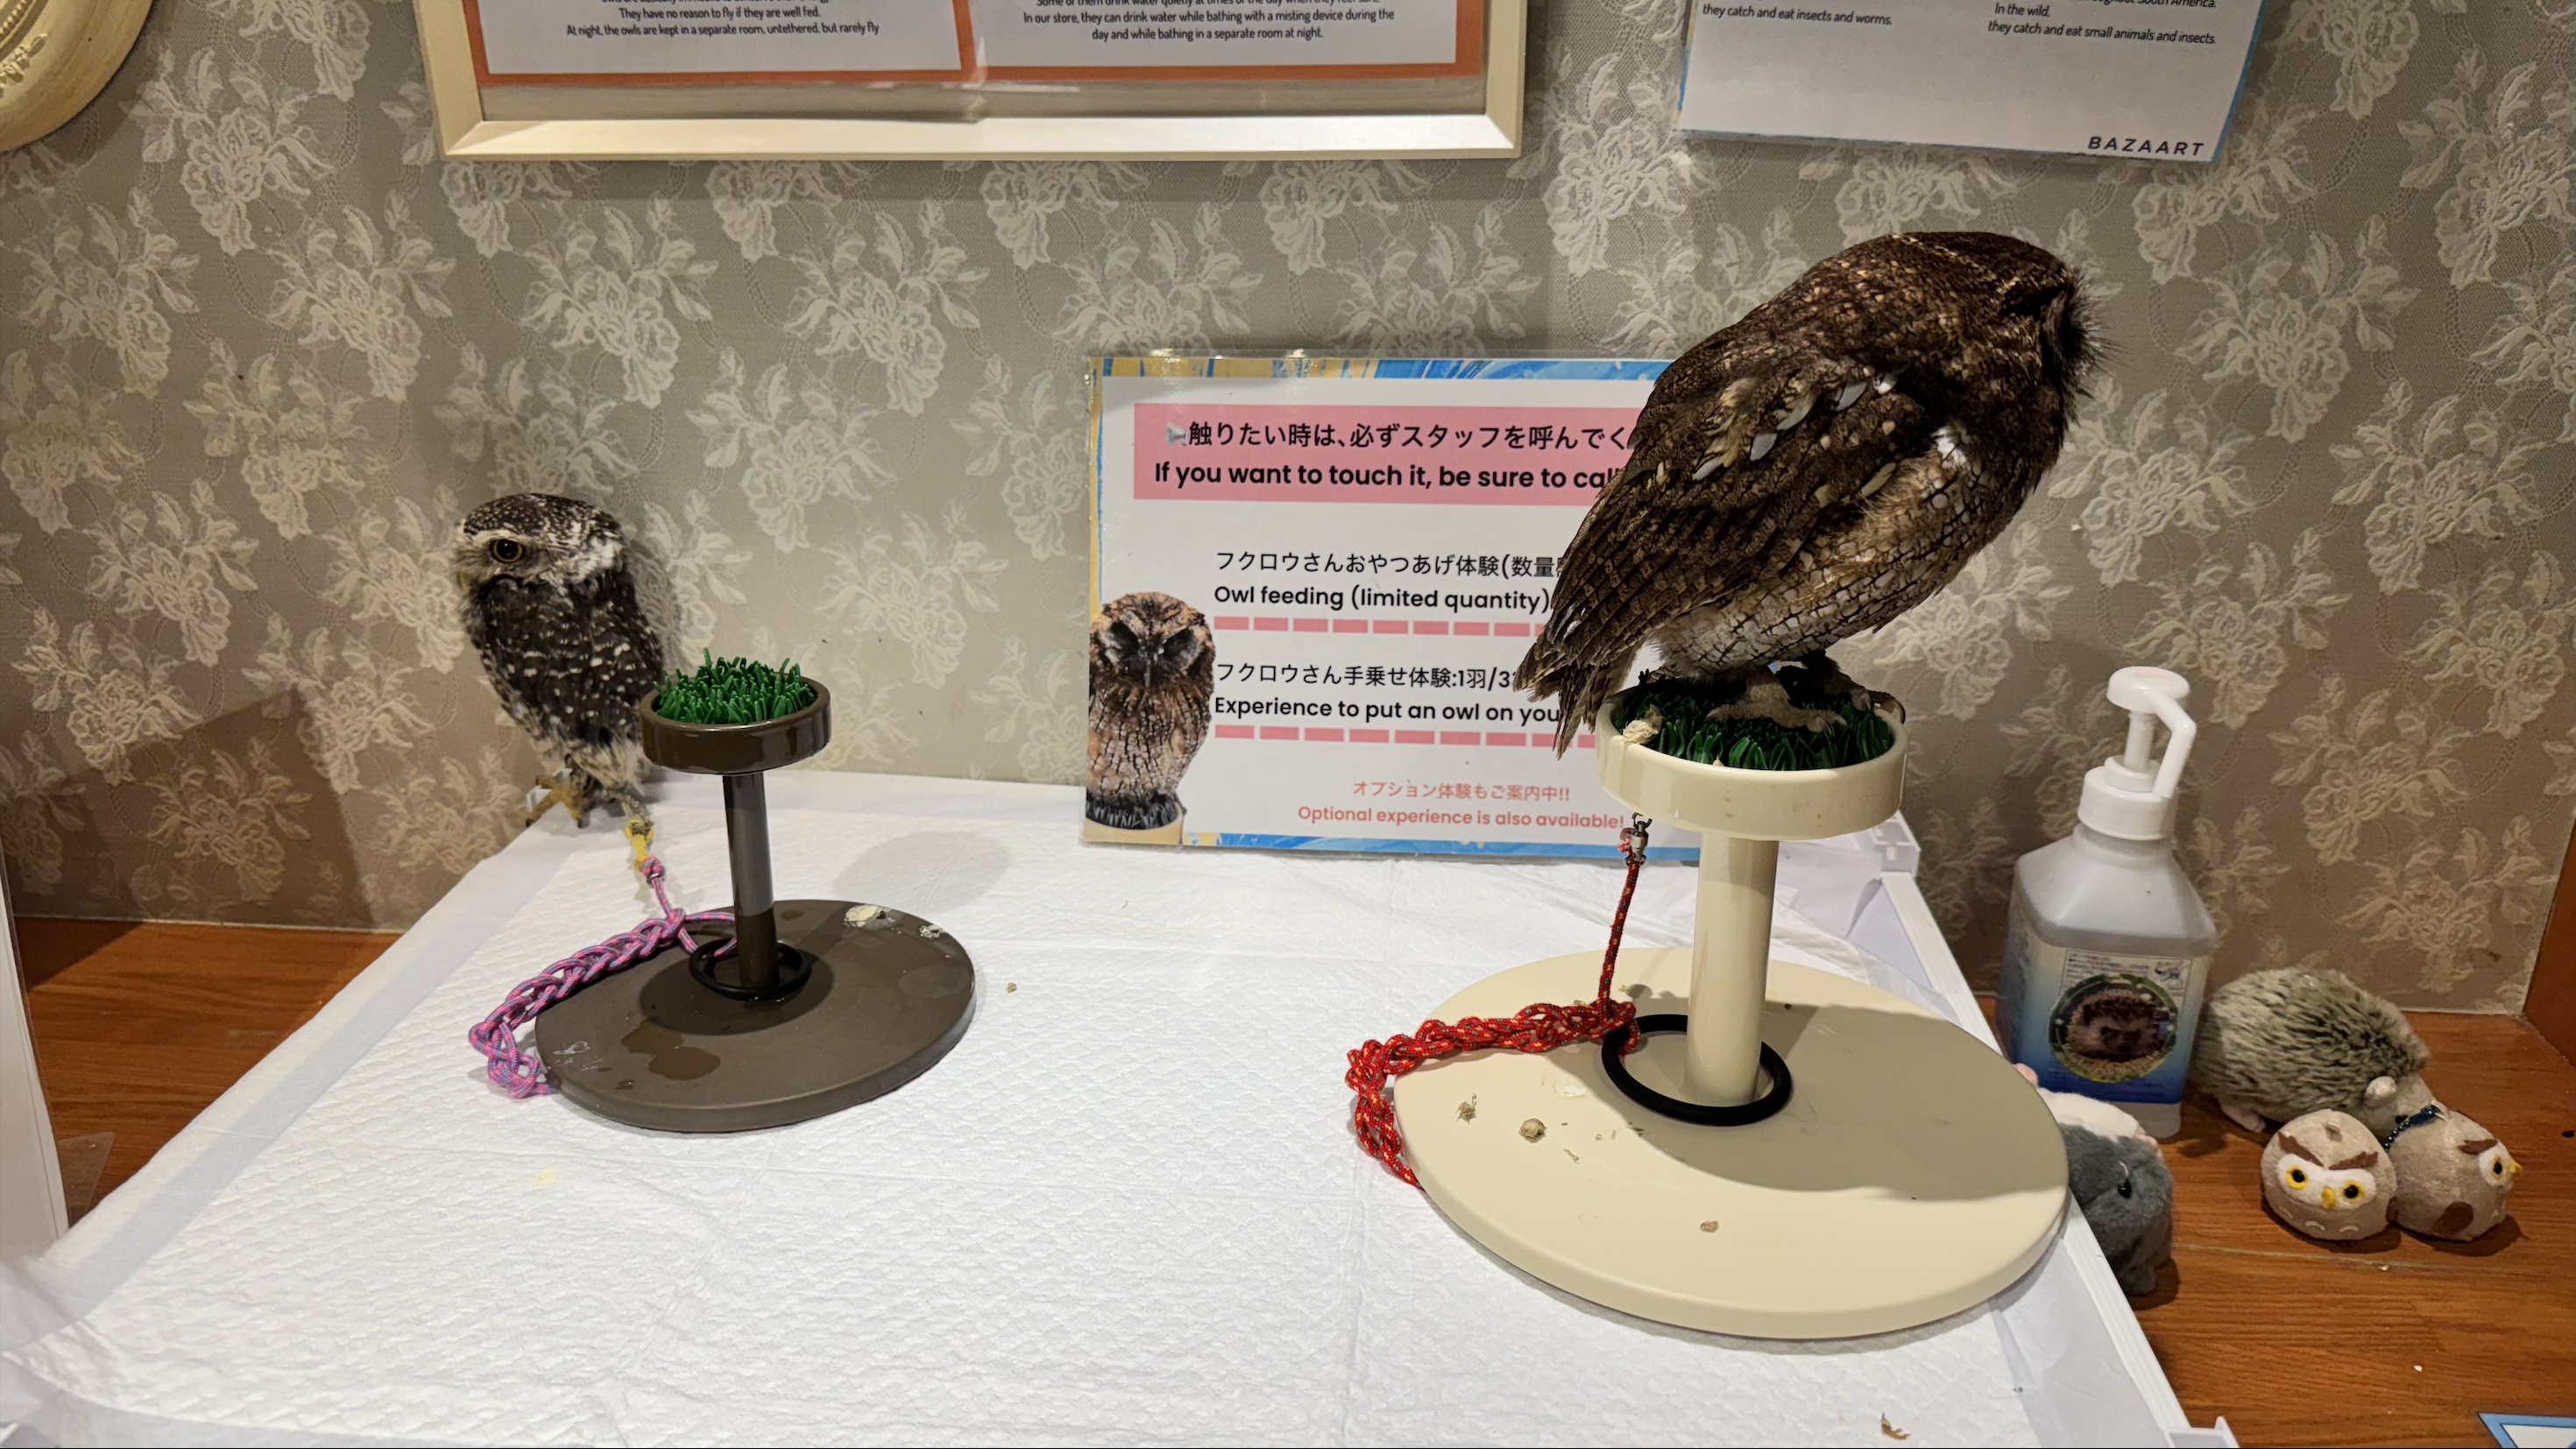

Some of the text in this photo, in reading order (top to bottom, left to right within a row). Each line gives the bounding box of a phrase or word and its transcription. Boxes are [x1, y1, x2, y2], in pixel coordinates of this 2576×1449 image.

[618, 5, 821, 22] They have no reason to fly if they are well fed.
[1023, 11, 1033, 24] In
[1034, 14, 1051, 24] our
[1080, 11, 1103, 26] they
[1103, 14, 1122, 24] can
[1122, 11, 1149, 24] drink
[1149, 11, 1178, 23] water
[1178, 10, 1205, 23] while
[1206, 10, 1243, 25] bathing
[1243, 9, 1266, 22] with
[1267, 12, 1274, 22] a
[1275, 10, 1312, 25] misting
[1312, 9, 1344, 21] device
[1345, 8, 1377, 24] during
[1378, 8, 1395, 20] the
[1702, 3, 1893, 25] they catch and eat insects and worms.
[1994, 2, 2006, 14] In
[2006, 3, 2026, 16] the
[566, 24, 577, 36] At
[603, 24, 619, 36] the
[620, 24, 642, 36] owls
[642, 26, 658, 36] are
[658, 24, 680, 38] kept
[680, 25, 690, 35] in
[690, 26, 697, 35] a
[697, 24, 737, 38] separate
[821, 22, 839, 33] but
[839, 21, 867, 36] rarely
[867, 20, 880, 36] fly
[1092, 28, 1109, 43] day
[1110, 27, 1129, 40] and
[1130, 27, 1157, 39] while
[1157, 27, 1194, 43] bathing
[1206, 31, 1213, 39] a
[1214, 27, 1256, 42] separate
[1256, 30, 1284, 39] room
[1284, 27, 1295, 39] at
[1296, 25, 1323, 41] night.
[1988, 19, 2217, 45] they catch and eat small animals and insects.
[2087, 136, 2204, 156] BAZAART
[1155, 461, 1171, 483] If
[1175, 466, 1221, 489] you
[1228, 464, 1292, 484] want
[1297, 464, 1323, 484] to
[1328, 464, 1403, 486] touch
[1409, 463, 1432, 490] it,
[1439, 465, 1471, 487] be
[1477, 470, 1534, 488] sure
[1540, 468, 1567, 488] to
[1214, 583, 1551, 616] Owl feeding (limited quantity)
[1217, 663, 1516, 691] フクロウさん手乗せ体験:1羽/3
[1214, 696, 1333, 719] Experience
[1338, 701, 1360, 717] to
[1365, 702, 1403, 724] put
[1407, 705, 1436, 719] an
[1441, 703, 1480, 721] owl
[1485, 707, 1513, 721] on
[1353, 779, 1570, 802] オプション体験もご案内中!!
[1298, 806, 1625, 831] Optional experience is also available!
